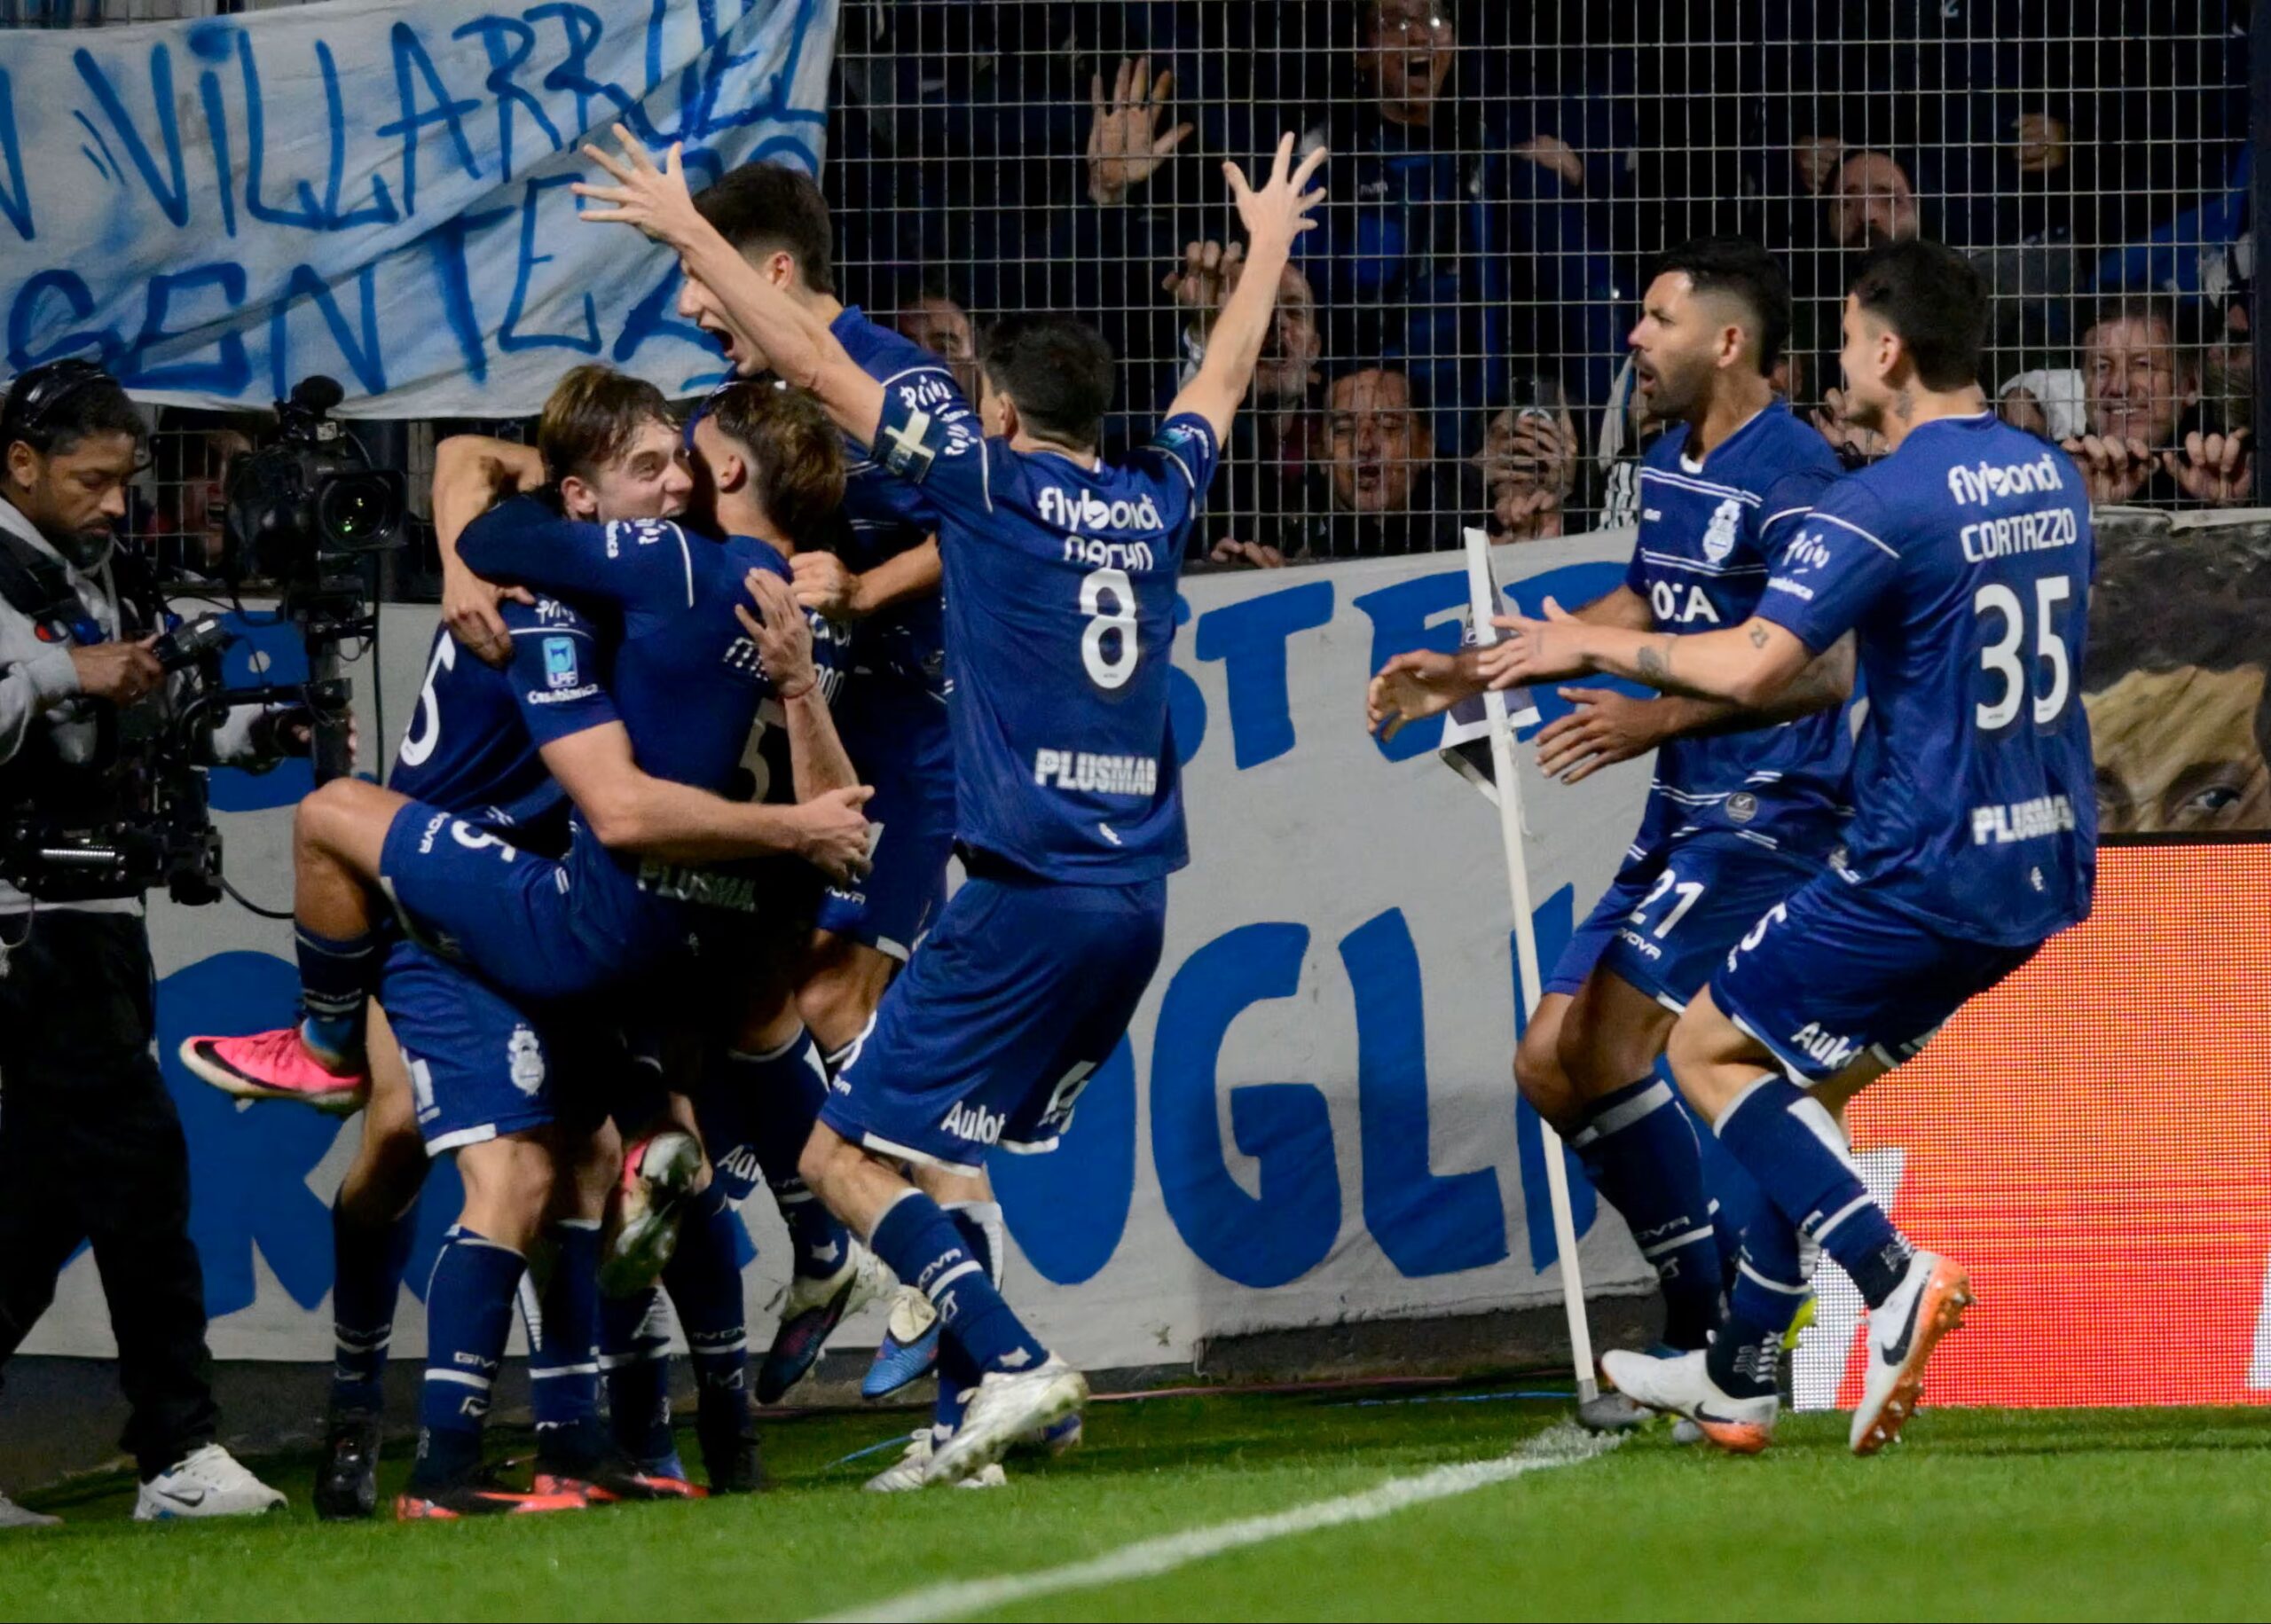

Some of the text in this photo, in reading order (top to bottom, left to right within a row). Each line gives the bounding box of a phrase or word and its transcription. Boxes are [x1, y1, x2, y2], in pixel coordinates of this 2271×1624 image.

[1947, 452, 2064, 506] flybondi
[1960, 507, 2078, 563] CORTAZZO
[1079, 567, 1139, 689] 8
[1975, 575, 2071, 730] 35
